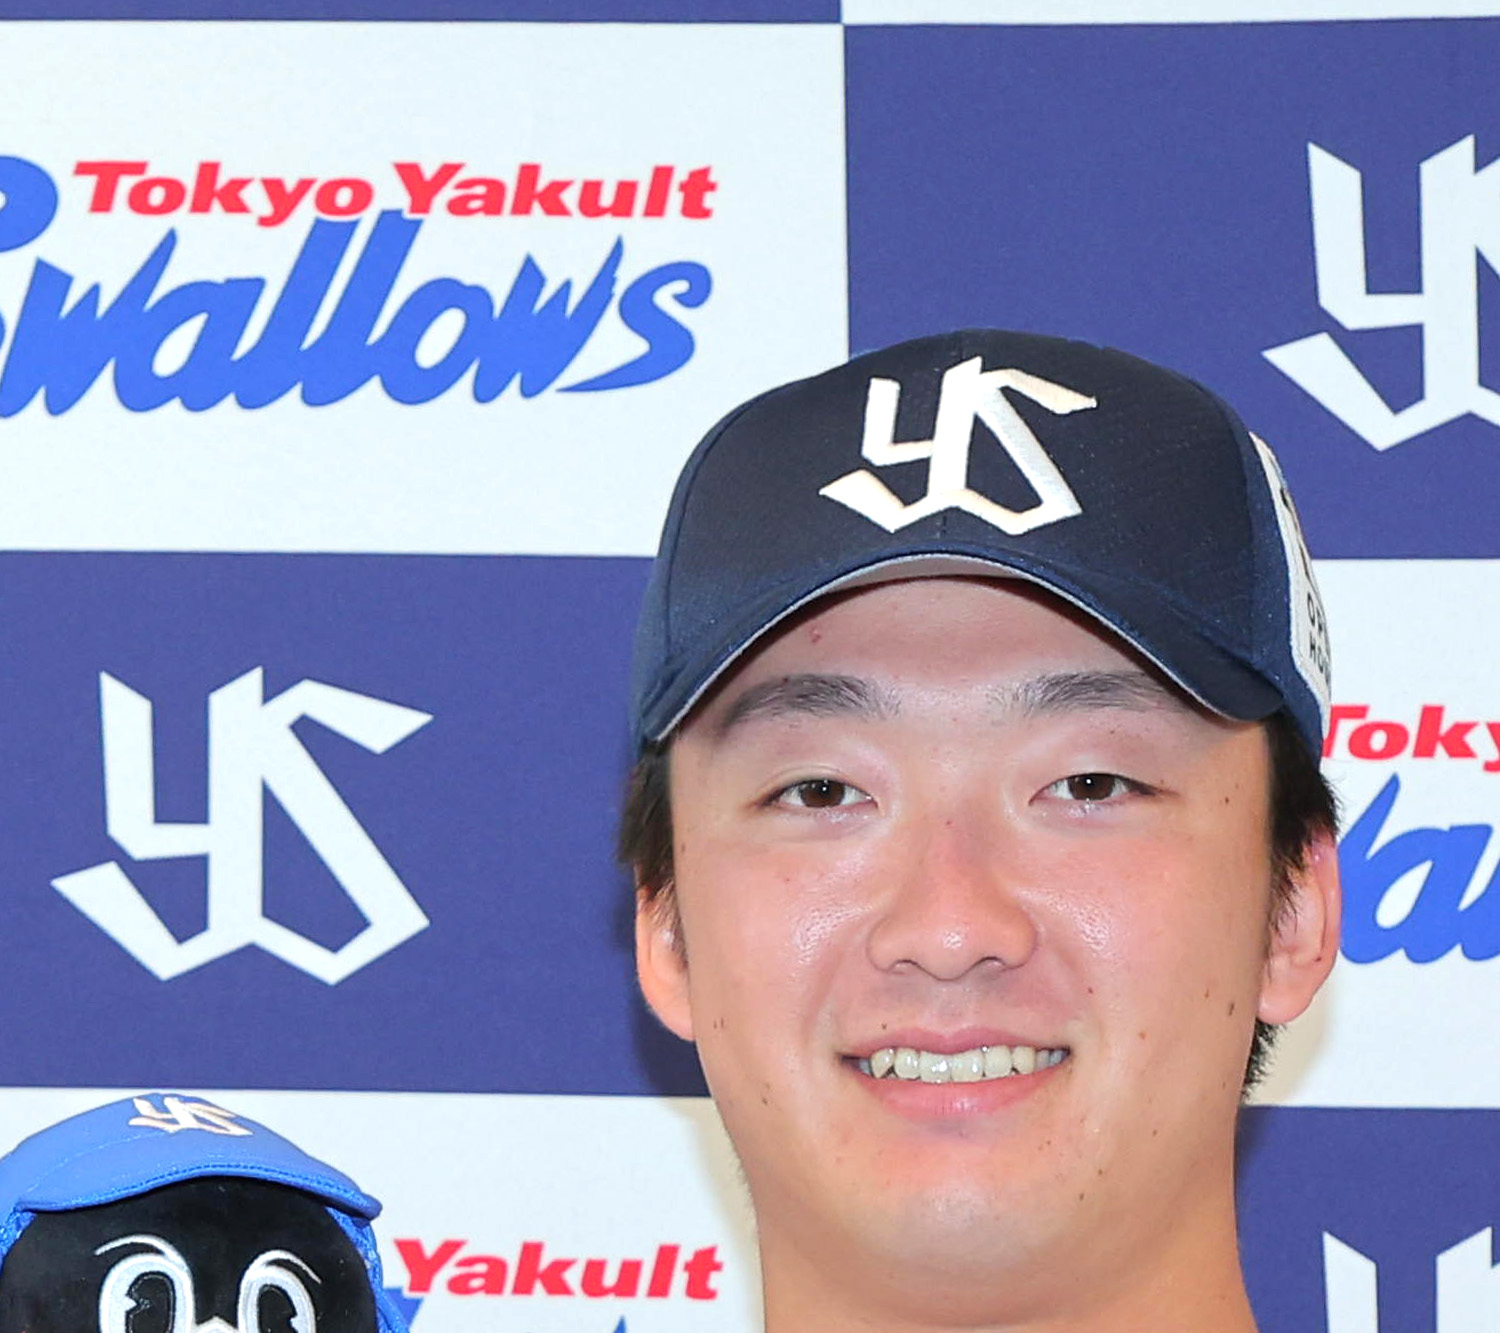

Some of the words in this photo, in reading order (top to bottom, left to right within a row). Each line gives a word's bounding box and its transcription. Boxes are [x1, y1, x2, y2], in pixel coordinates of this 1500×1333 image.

[74, 160, 374, 228] Tokyo
[393, 160, 718, 220] Yakult
[394, 1237, 723, 1301] Yakult
